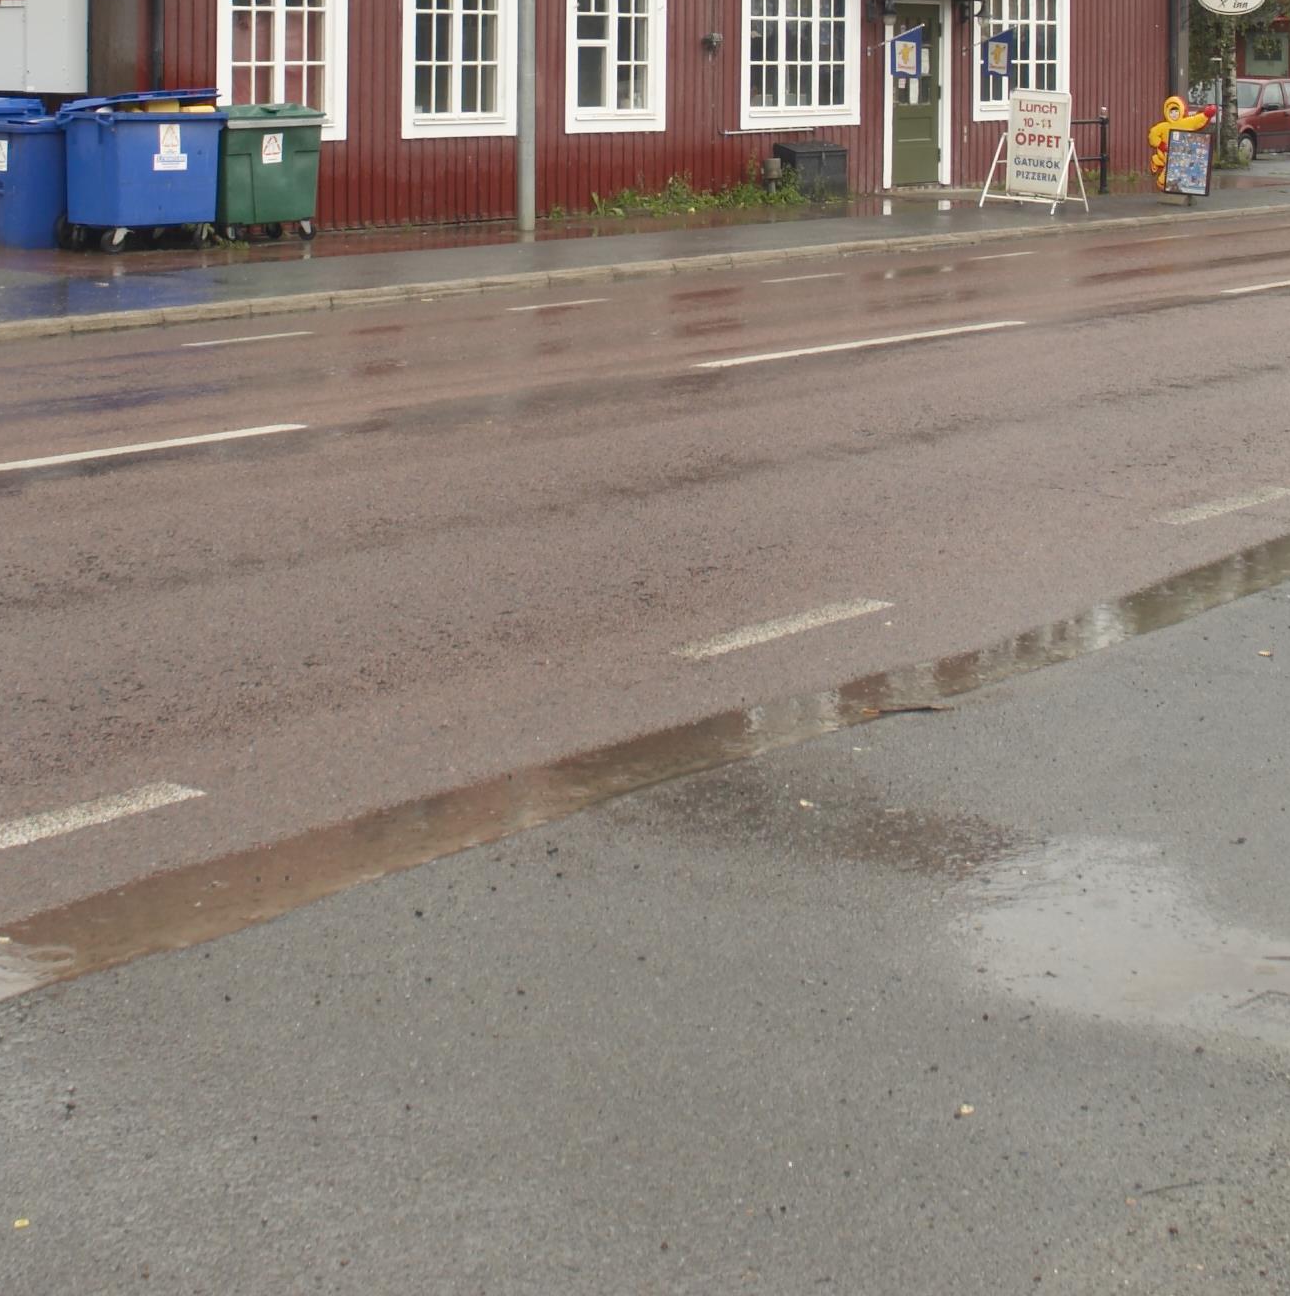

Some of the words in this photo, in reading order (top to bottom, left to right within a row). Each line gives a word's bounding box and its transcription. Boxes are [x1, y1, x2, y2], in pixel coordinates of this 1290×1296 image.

[1019, 100, 1058, 114] Lunch
[1015, 128, 1061, 148] ÖPPET
[1014, 156, 1060, 169] GATUKÖK
[1016, 170, 1057, 182] PIZZERIA
